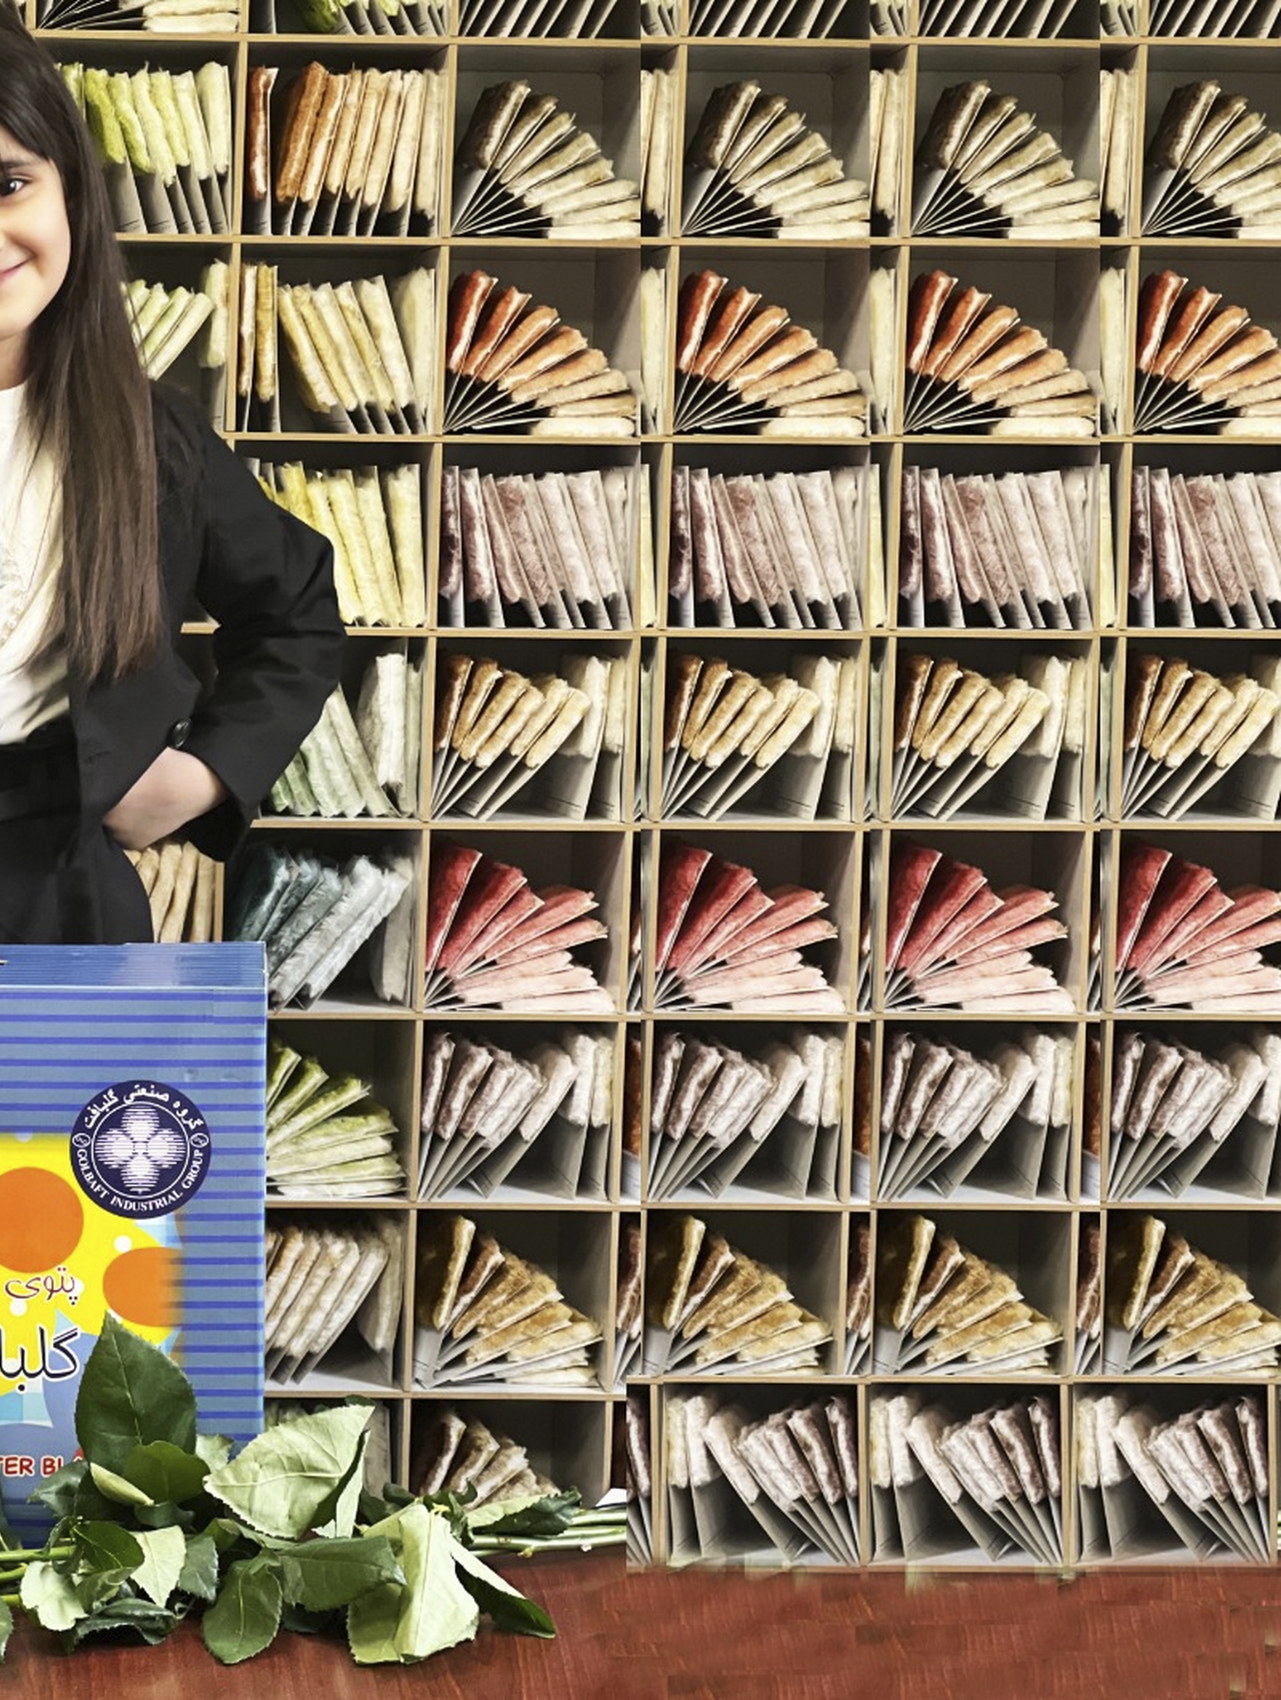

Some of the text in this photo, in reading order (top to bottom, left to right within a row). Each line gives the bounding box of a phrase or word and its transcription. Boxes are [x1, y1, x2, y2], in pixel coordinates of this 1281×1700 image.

[84, 1084, 204, 1130] گروه صنعتی گلبافت
[76, 1148, 204, 1212] GOLBAFT INDUSTRIAL GROUP
[5, 1266, 78, 1306] پتوی
